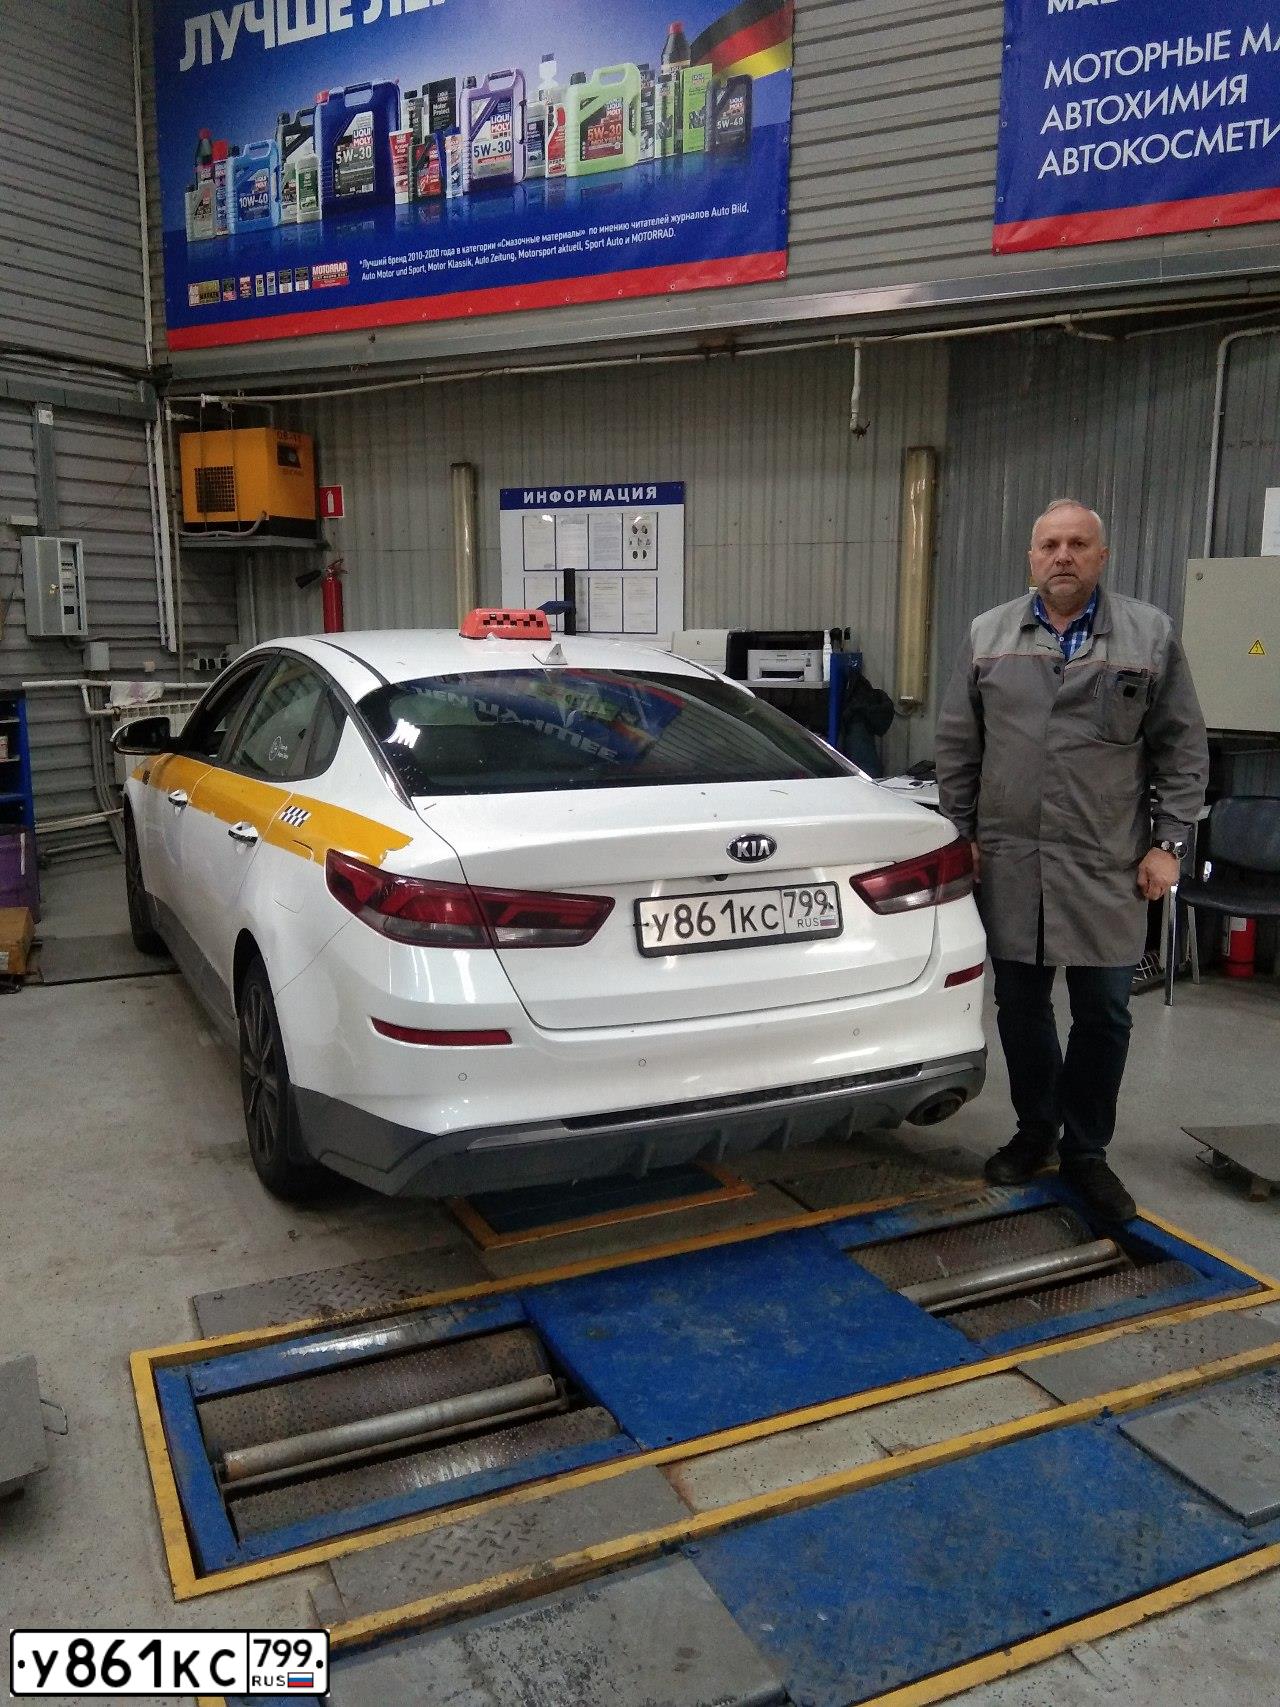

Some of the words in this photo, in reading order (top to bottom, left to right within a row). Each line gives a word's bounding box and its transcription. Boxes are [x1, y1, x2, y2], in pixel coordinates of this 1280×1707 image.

[180, 0, 353, 72] ЛУЧШЕ
[1043, 29, 1232, 89] МОТОРНЫЕ
[1240, 22, 1280, 57] М
[1039, 74, 1248, 135] АВТОХИМИЯ
[353, 127, 372, 138] LIQUI
[491, 122, 510, 132] MOLY
[353, 136, 372, 147] MOLY
[473, 140, 511, 158] 5W-30
[1037, 118, 1280, 180] АВТОКОСМЕТИ
[336, 146, 372, 164] 5W-30
[240, 193, 268, 208] 10W-40
[388, 256, 407, 266] бренд
[408, 248, 440, 262] 2010-2020
[440, 248, 456, 256] года
[462, 242, 496, 254] категории
[497, 236, 540, 248] «Смазочные
[542, 229, 586, 242] материалы»
[588, 228, 598, 236] по
[599, 222, 630, 234] мнению
[630, 214, 669, 228] читателей
[670, 210, 710, 224] журналов
[711, 206, 730, 217] Auto
[732, 202, 749, 214] Bild,
[362, 272, 376, 281] Auto
[376, 270, 394, 278] Motor
[396, 266, 408, 276] und
[408, 264, 426, 276] Sport,
[428, 262, 446, 272] Motor
[448, 258, 474, 269] Klassik,
[474, 256, 490, 265] Auto
[490, 252, 517, 262] Zeitung,
[518, 246, 557, 258] Motorsport
[558, 244, 584, 254] aktuell,
[584, 238, 604, 251] Sport
[606, 236, 624, 247] Auto
[632, 227, 676, 244] MOTORRAD.
[312, 262, 348, 276] MOTORRAD
[523, 486, 657, 503] ИНФОРМАЦИЯ
[736, 839, 772, 858] KIA
[651, 899, 779, 941] У861КС
[783, 889, 829, 918] 799
[797, 918, 820, 928] RUS
